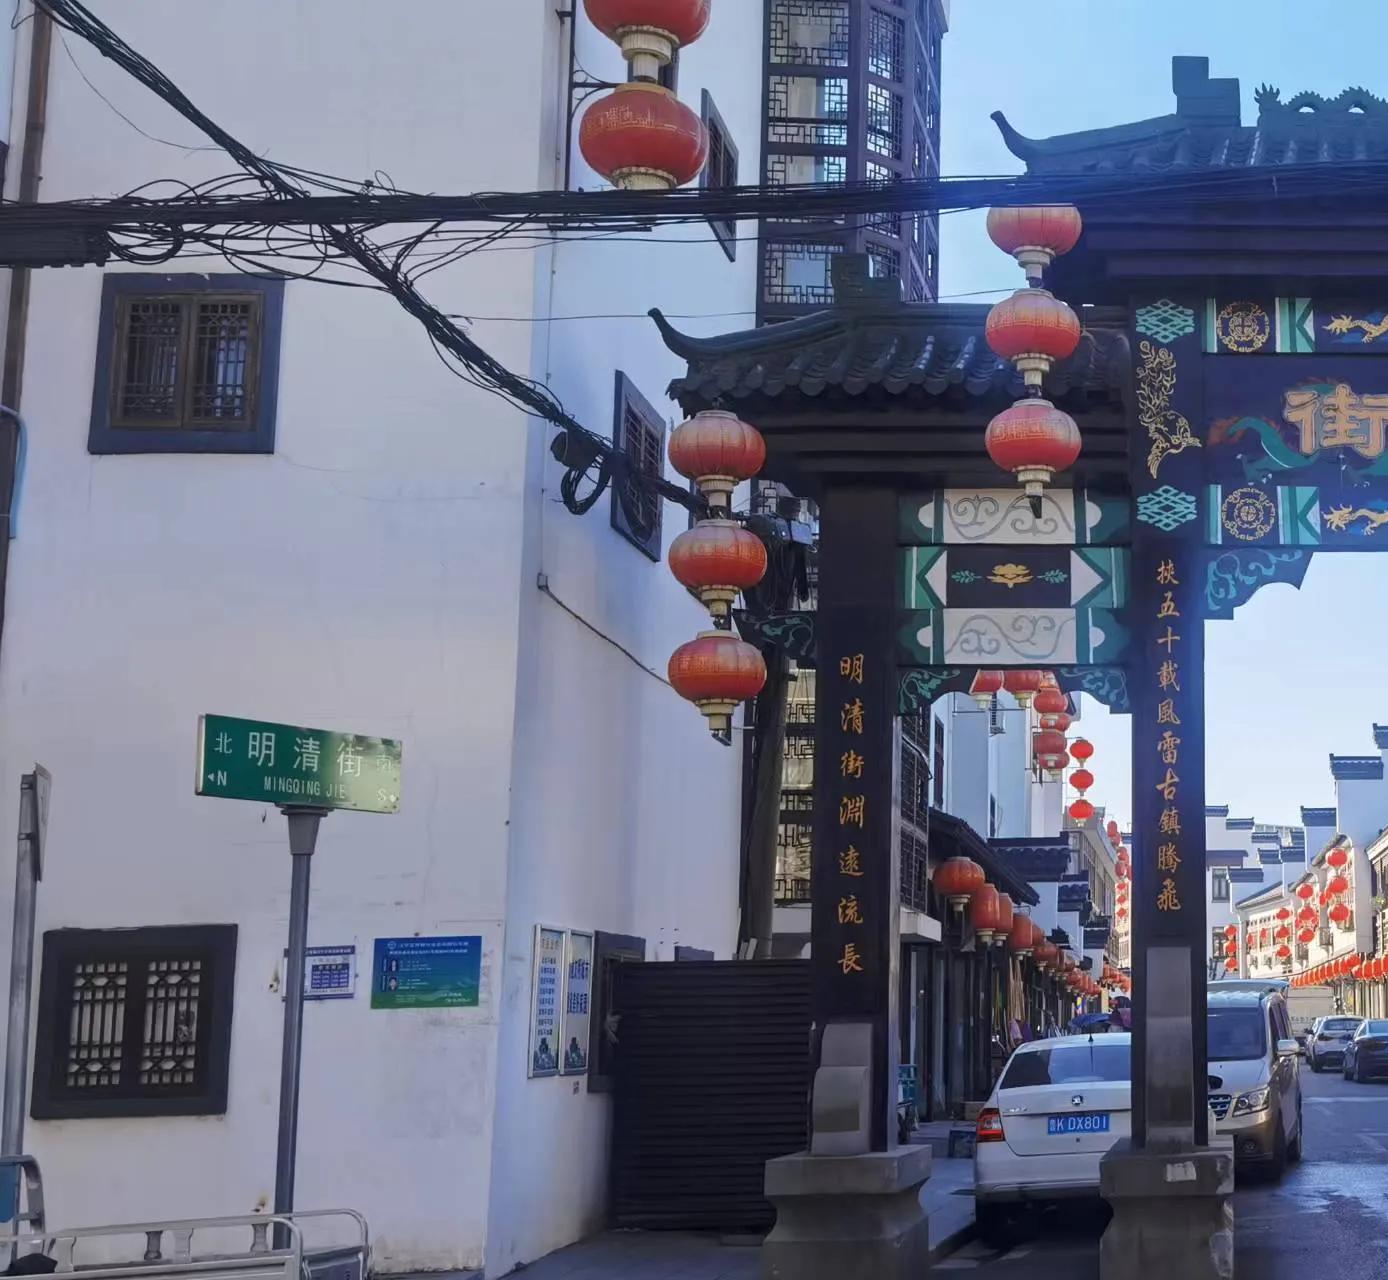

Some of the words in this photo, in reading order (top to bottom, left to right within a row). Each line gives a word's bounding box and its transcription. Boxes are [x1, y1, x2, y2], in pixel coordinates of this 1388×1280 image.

[214, 732, 232, 754] 北
[248, 731, 363, 777] 明清街
[217, 770, 227, 786] N
[263, 775, 321, 795] MINGQING
[326, 783, 346, 799] JIE
[377, 788, 386, 801] S
